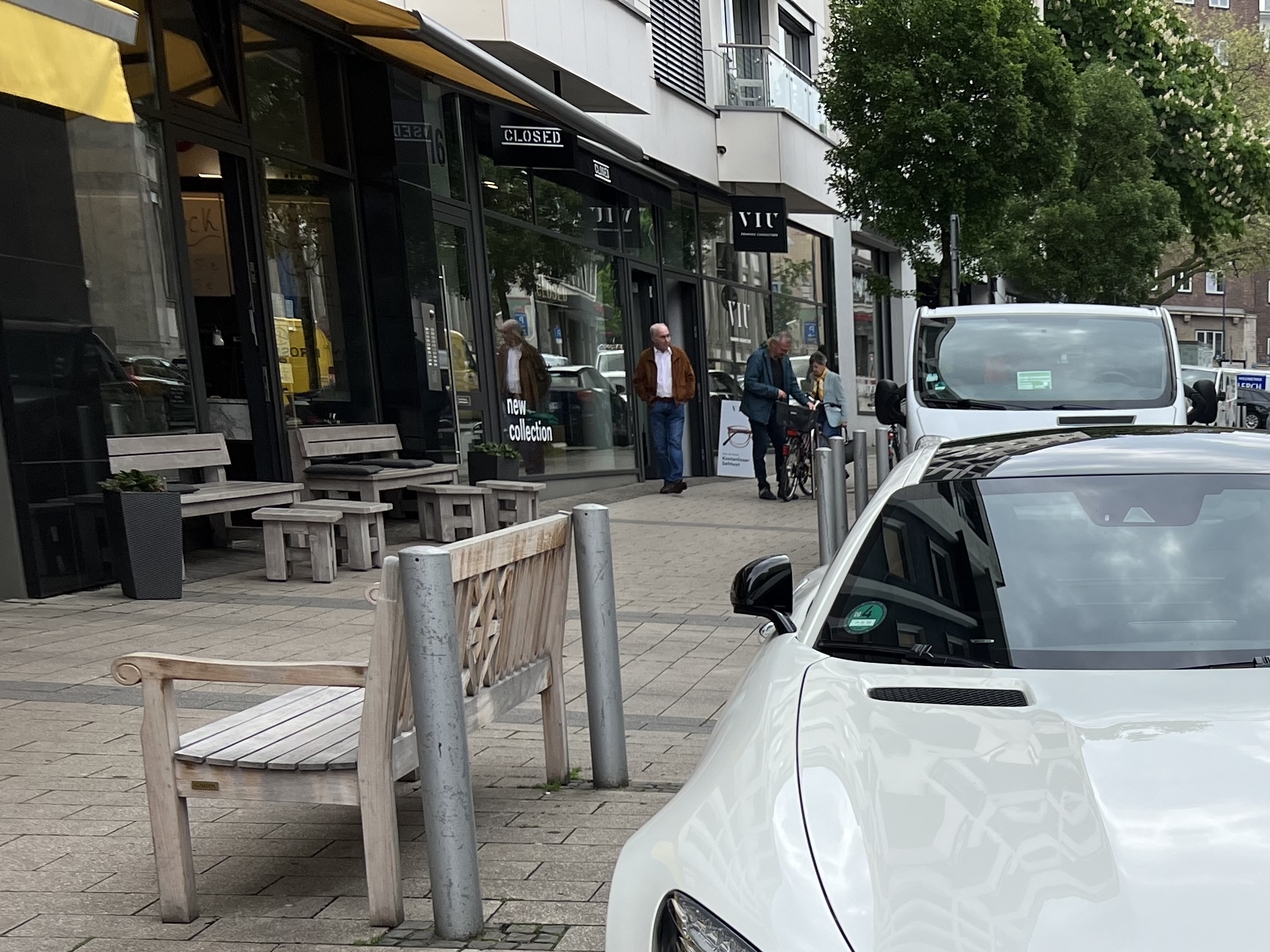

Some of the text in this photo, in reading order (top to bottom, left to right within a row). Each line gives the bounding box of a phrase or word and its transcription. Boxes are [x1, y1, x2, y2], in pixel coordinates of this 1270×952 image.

[504, 130, 561, 144] CLOSED
[594, 164, 610, 179] CLOSED
[739, 211, 779, 228] VIU
[727, 300, 750, 329] VIU
[507, 398, 526, 415] new
[509, 418, 553, 441] collection
[861, 605, 874, 618] 4
